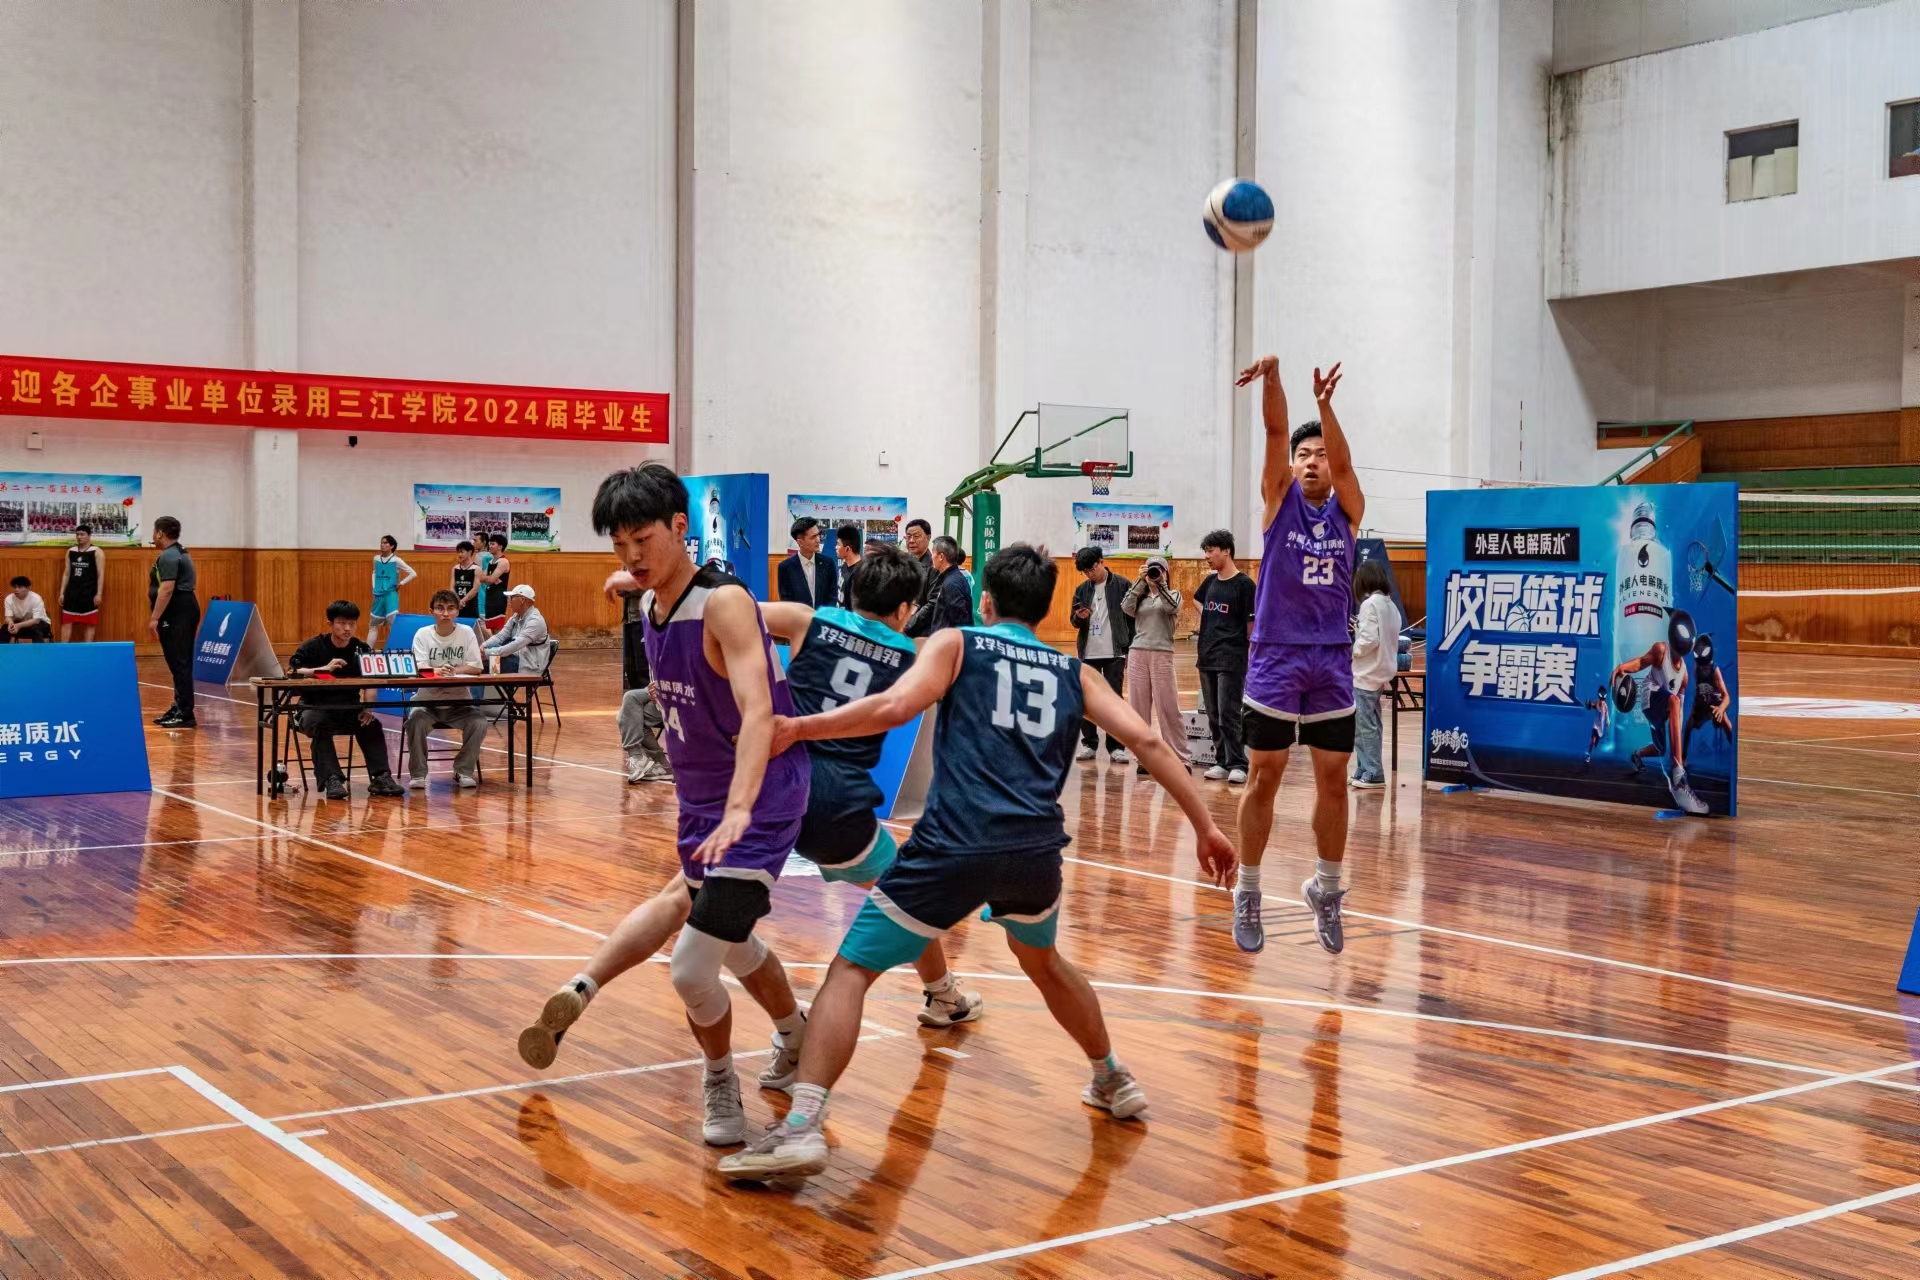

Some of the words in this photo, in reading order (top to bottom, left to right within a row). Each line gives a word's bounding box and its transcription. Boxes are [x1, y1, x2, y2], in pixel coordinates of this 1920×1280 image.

[0, 368, 652, 433] 迎各企事业单位录用三江学院2024届毕业生
[458, 587, 467, 596] 24
[1303, 555, 1335, 586] 23
[1438, 573, 1604, 651] 校园篮球
[362, 656, 385, 674] 06
[429, 646, 464, 660] LI-NING
[1460, 639, 1578, 704] 争霸赛
[821, 656, 874, 713] 9
[991, 658, 1058, 738] 13
